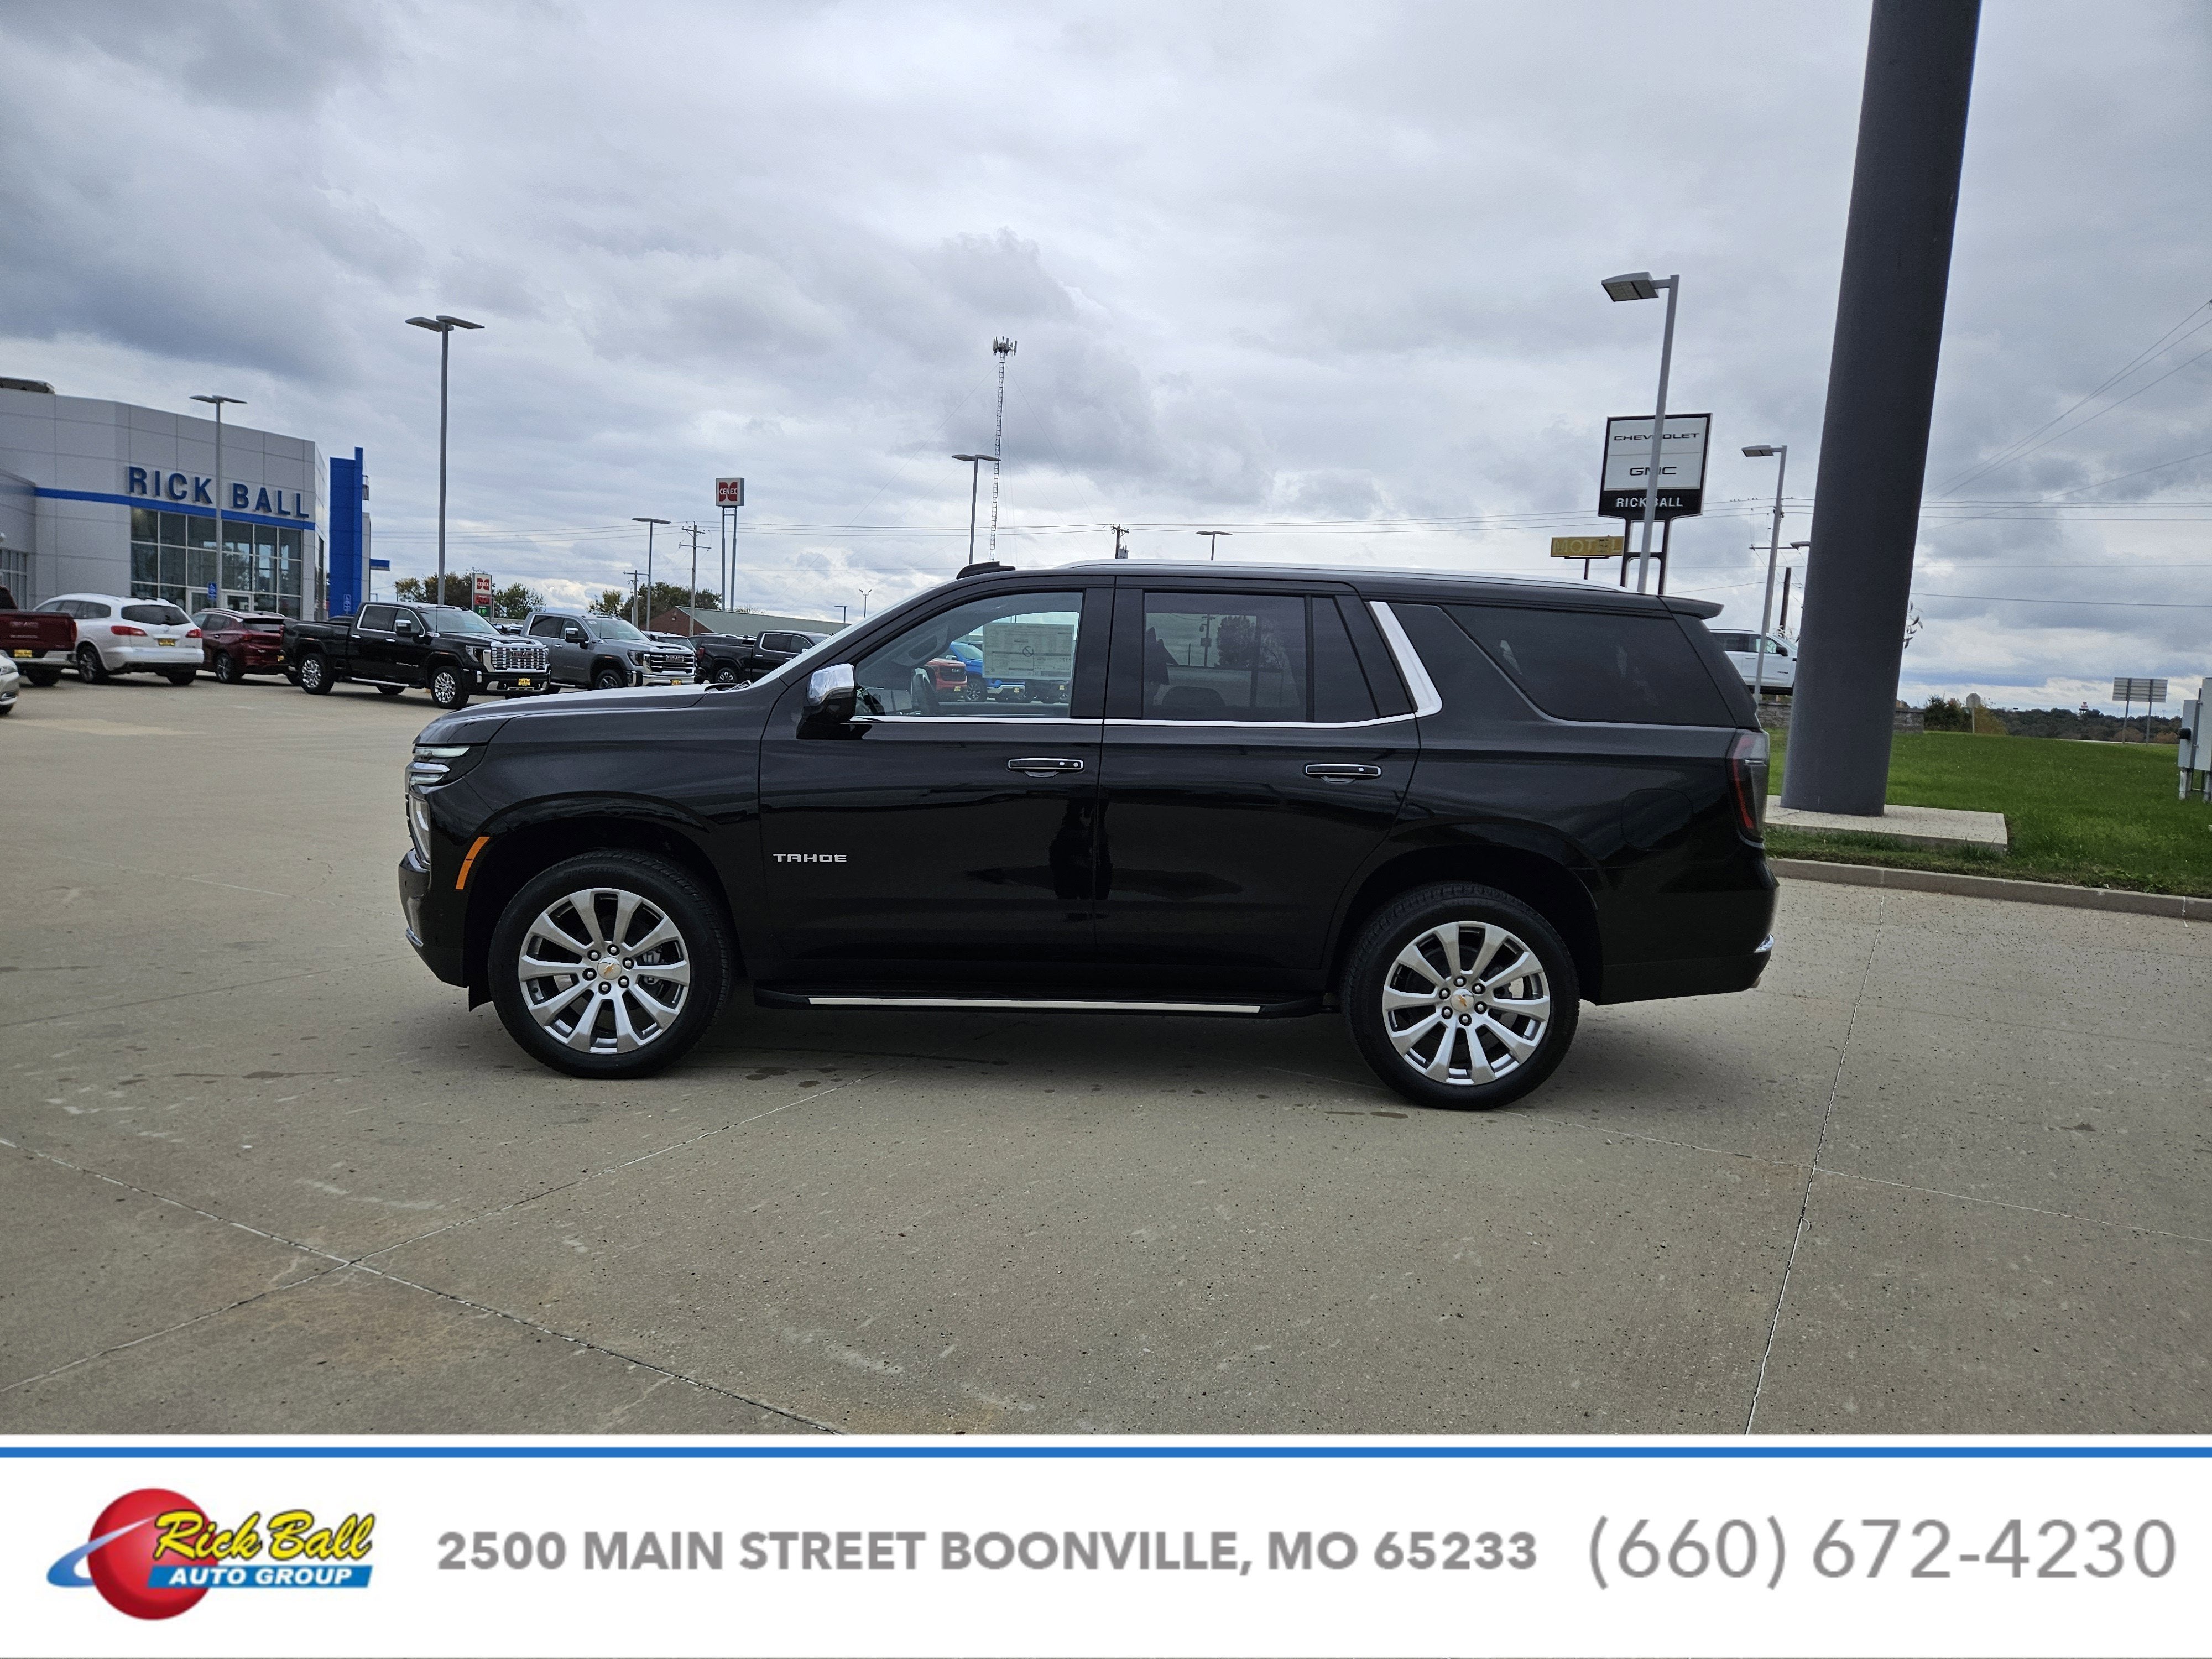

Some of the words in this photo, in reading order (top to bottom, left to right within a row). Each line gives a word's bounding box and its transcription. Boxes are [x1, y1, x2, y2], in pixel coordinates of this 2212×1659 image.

[129, 466, 213, 504] RICK
[231, 483, 310, 518] BALL
[1616, 498, 1647, 508] RICK
[1553, 539, 1622, 553] MOTEL
[773, 854, 847, 863] TAHOE
